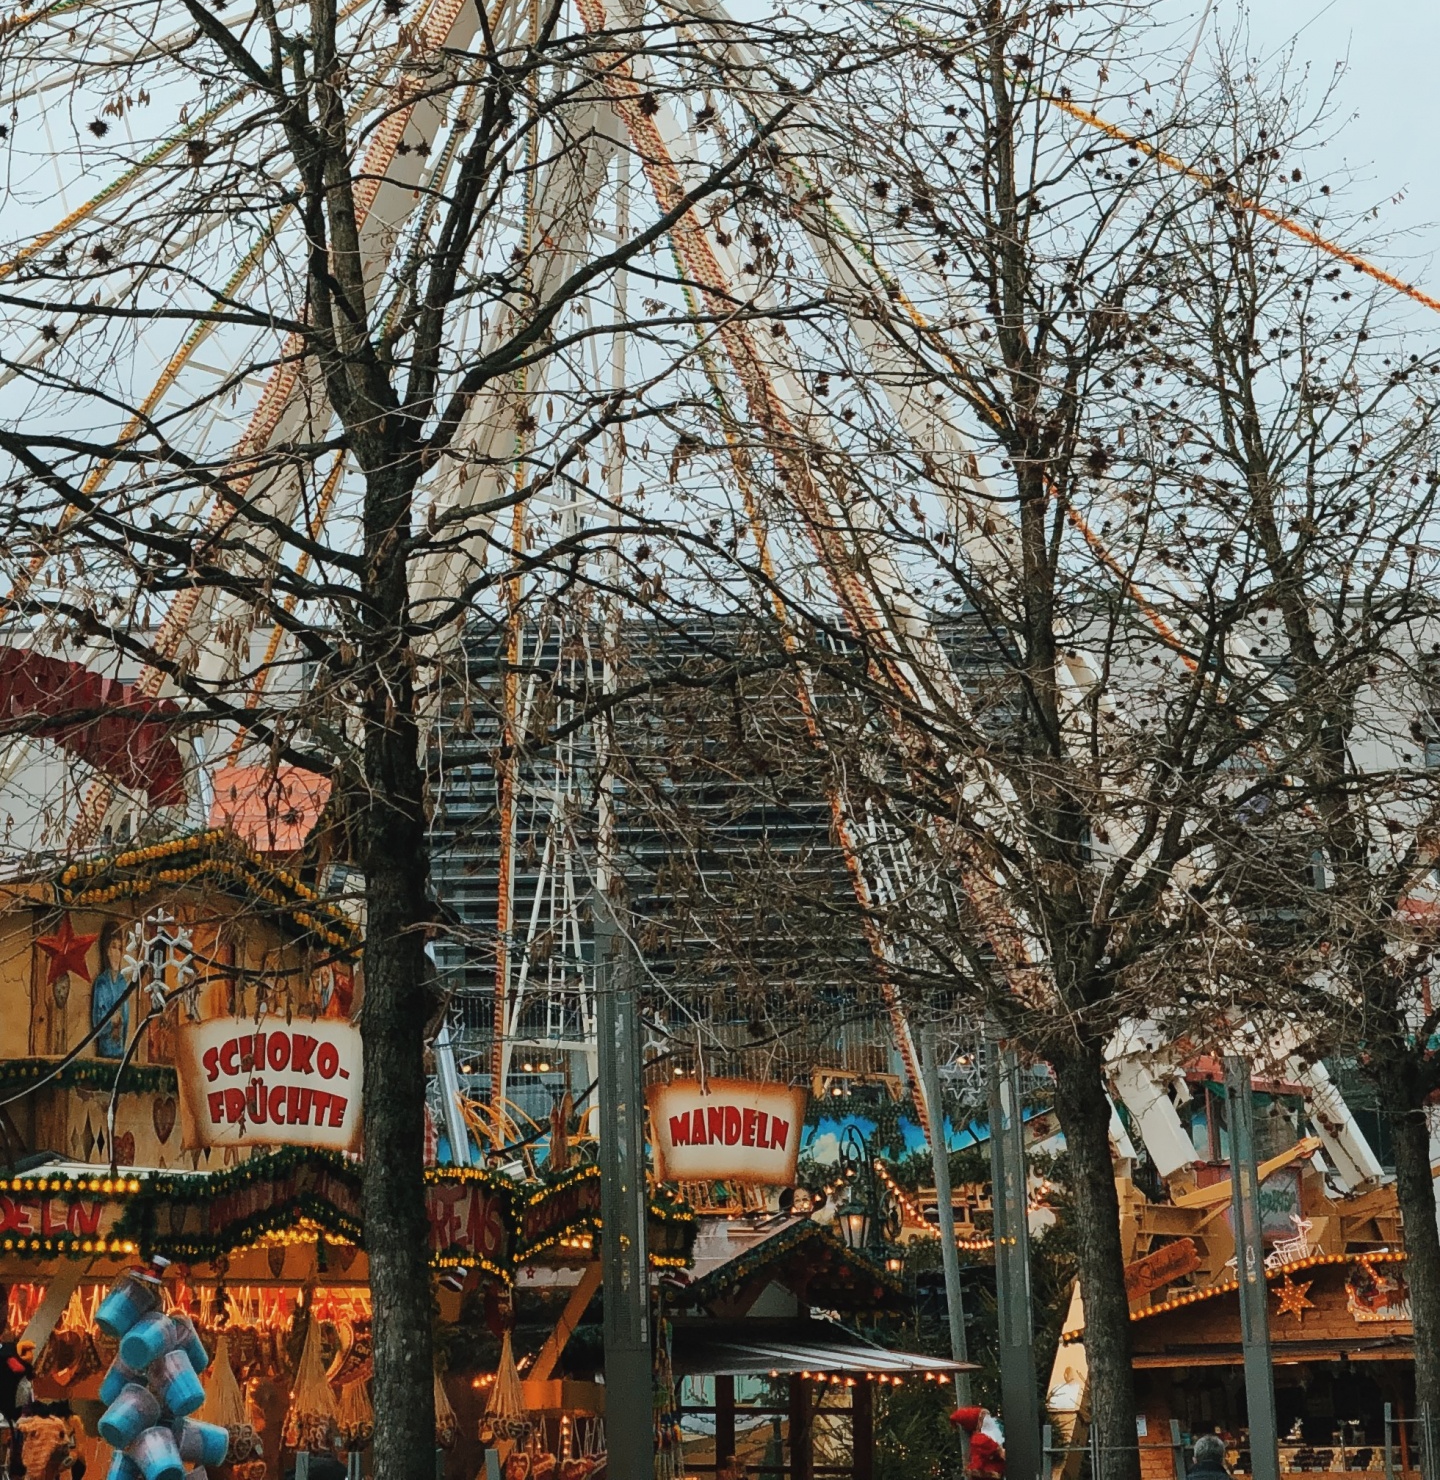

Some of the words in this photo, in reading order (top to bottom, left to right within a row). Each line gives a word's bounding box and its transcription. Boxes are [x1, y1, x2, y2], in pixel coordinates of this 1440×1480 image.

[203, 1031, 350, 1082] SCHOKO-
[207, 1077, 348, 1128] FRÜCHTE
[669, 1105, 789, 1151] MANDELN
